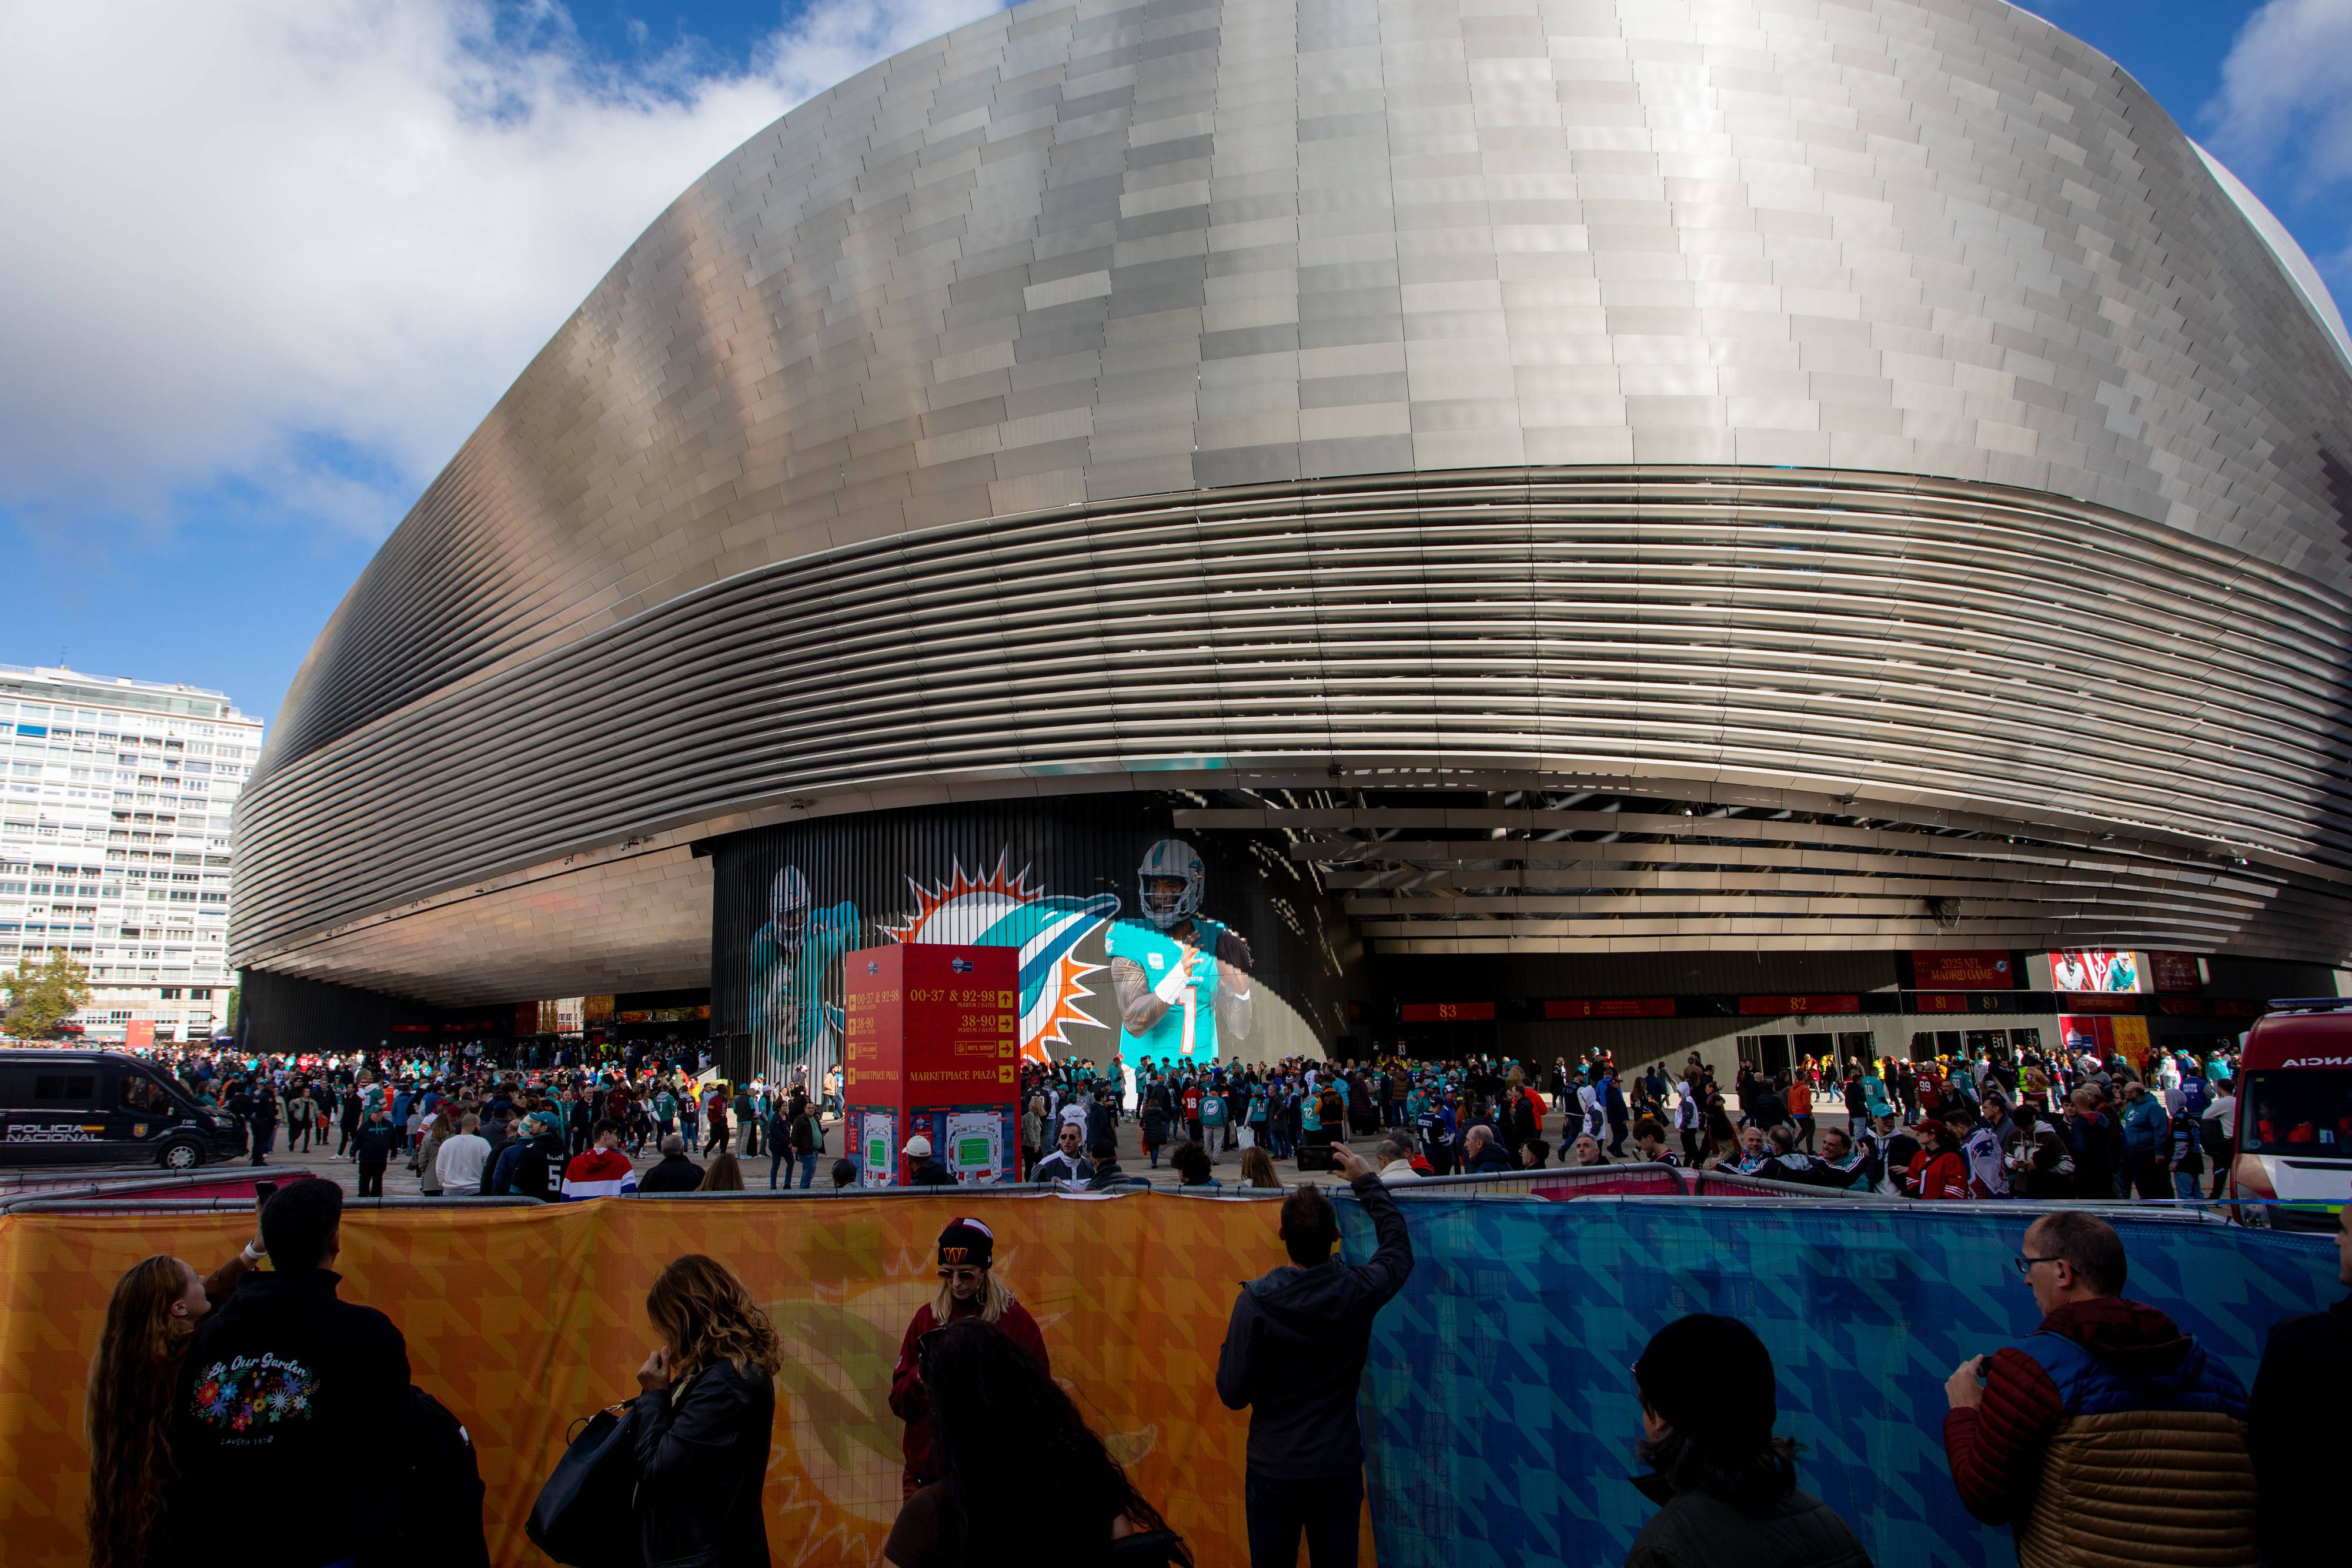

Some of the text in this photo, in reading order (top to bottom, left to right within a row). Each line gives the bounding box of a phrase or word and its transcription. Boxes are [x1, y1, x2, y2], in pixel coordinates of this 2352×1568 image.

[1941, 958, 1981, 969] 2025 NFL
[1931, 969, 1994, 981] MADRID GAME
[857, 989, 899, 1005] 00-37 & 92-98
[910, 989, 995, 1002] 00-37 & 92-98
[1790, 997, 1807, 1010] 82
[1935, 996, 1947, 1009] 81
[1983, 996, 1998, 1009] 80
[1439, 1004, 1457, 1018] 83
[857, 1017, 874, 1029] 38-90
[961, 1015, 996, 1027] 38-90
[1992, 1037, 2004, 1048] 81
[1398, 1044, 1406, 1056] 83
[856, 1070, 899, 1080] MARKETPLACE PLAZA
[910, 1070, 997, 1081] MARKETPLACE PLAZA
[1919, 1081, 1931, 1092] 99
[685, 1102, 695, 1114] 13
[1187, 1097, 1197, 1109] 16
[7, 1124, 84, 1134] POLICIA
[6, 1134, 104, 1142] NACIONAL
[1422, 1128, 1431, 1145] 4
[547, 1164, 562, 1192] 5
[206, 1352, 308, 1380] Be Our Garden
